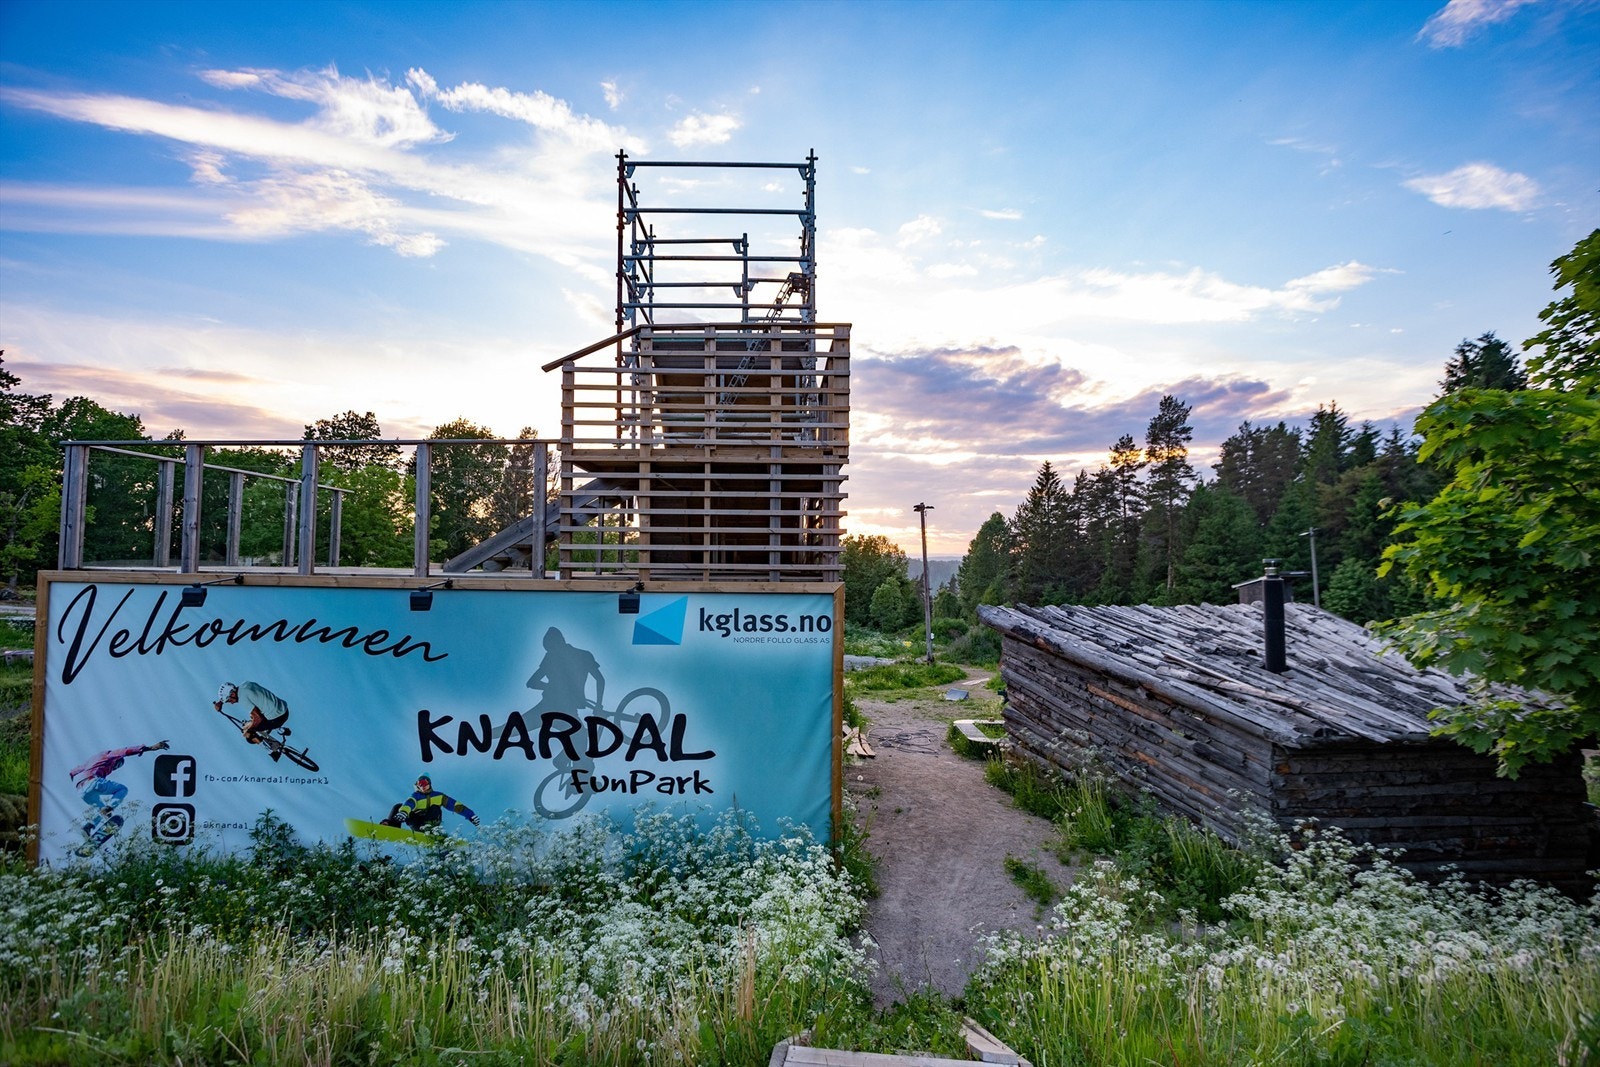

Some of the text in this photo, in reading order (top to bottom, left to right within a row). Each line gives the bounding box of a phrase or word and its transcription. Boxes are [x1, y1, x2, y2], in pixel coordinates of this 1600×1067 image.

[57, 584, 449, 685] Velkommen
[699, 607, 832, 638] kglass.no
[417, 709, 717, 763] KNARDAL
[570, 769, 714, 795] FunPark
